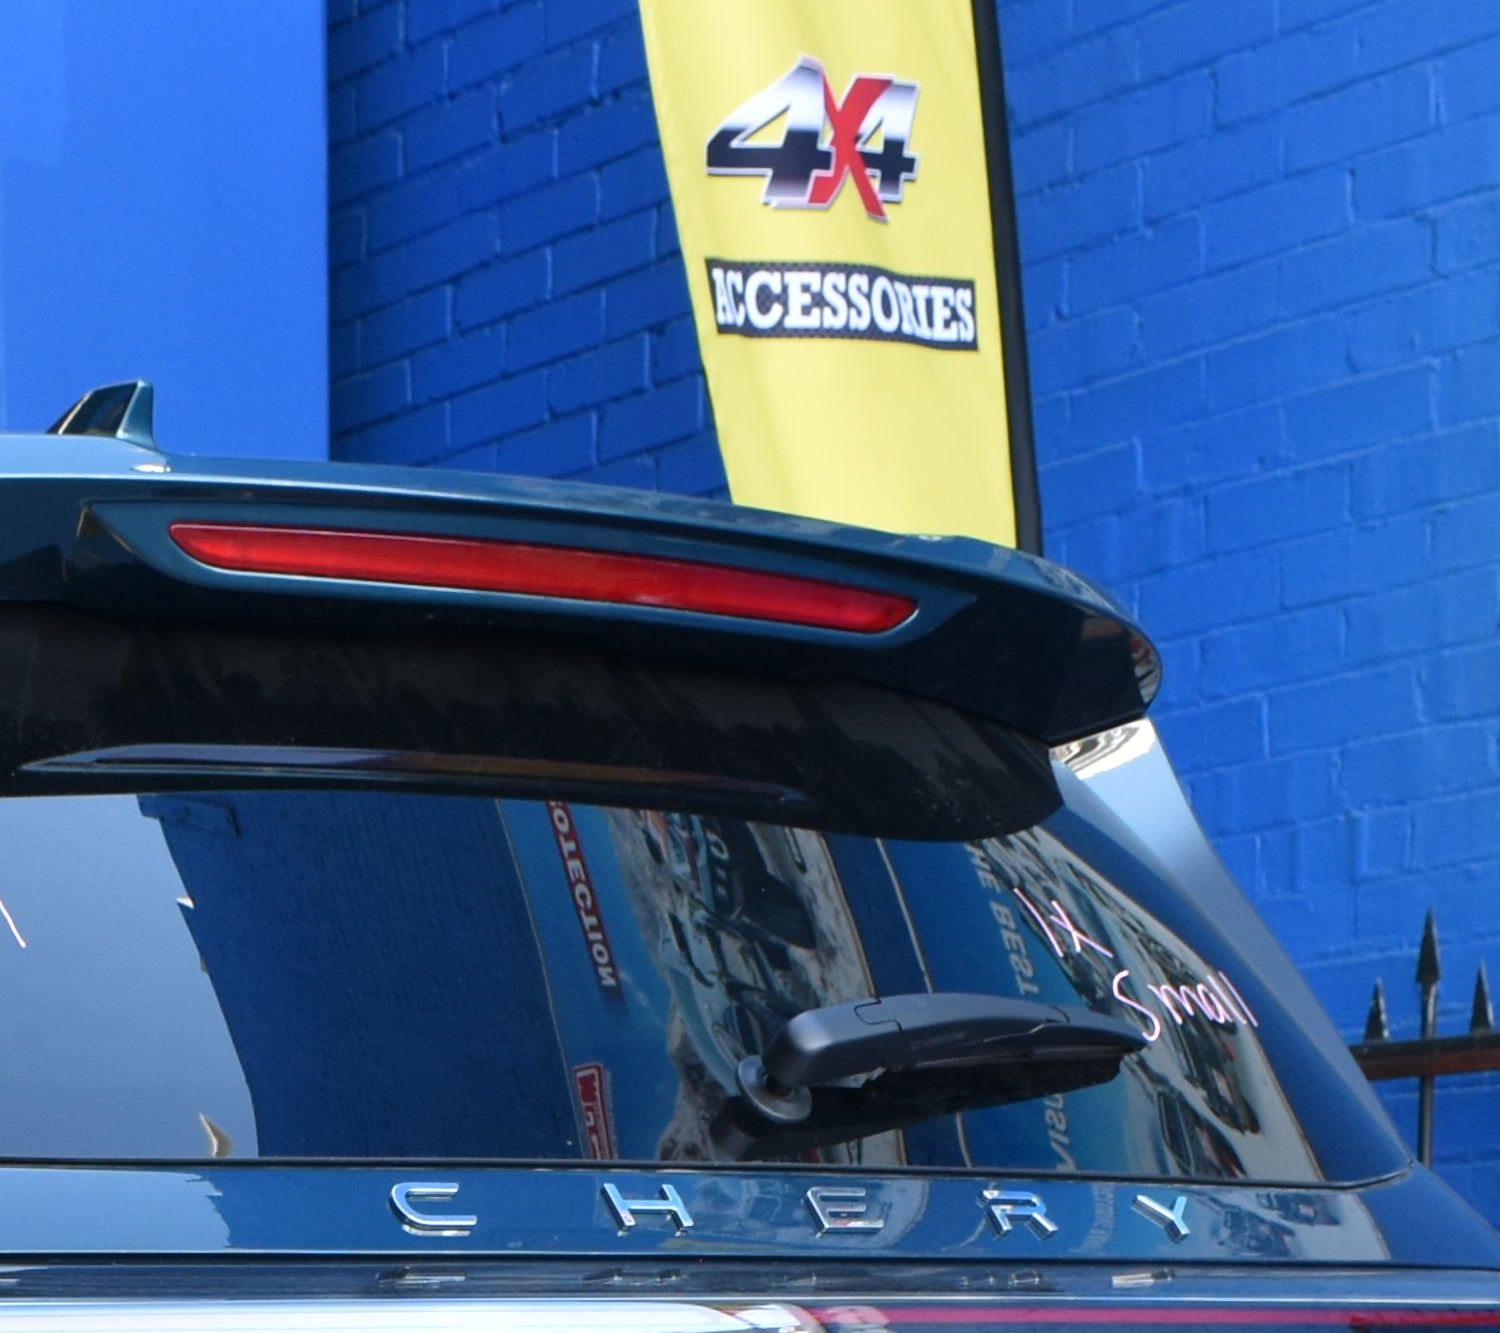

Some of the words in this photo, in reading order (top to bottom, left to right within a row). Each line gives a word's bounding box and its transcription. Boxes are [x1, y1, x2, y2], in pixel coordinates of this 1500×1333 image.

[711, 267, 976, 344] ACCESSORIES
[1111, 969, 1259, 1042] Small
[389, 1180, 1191, 1242] CHERY
